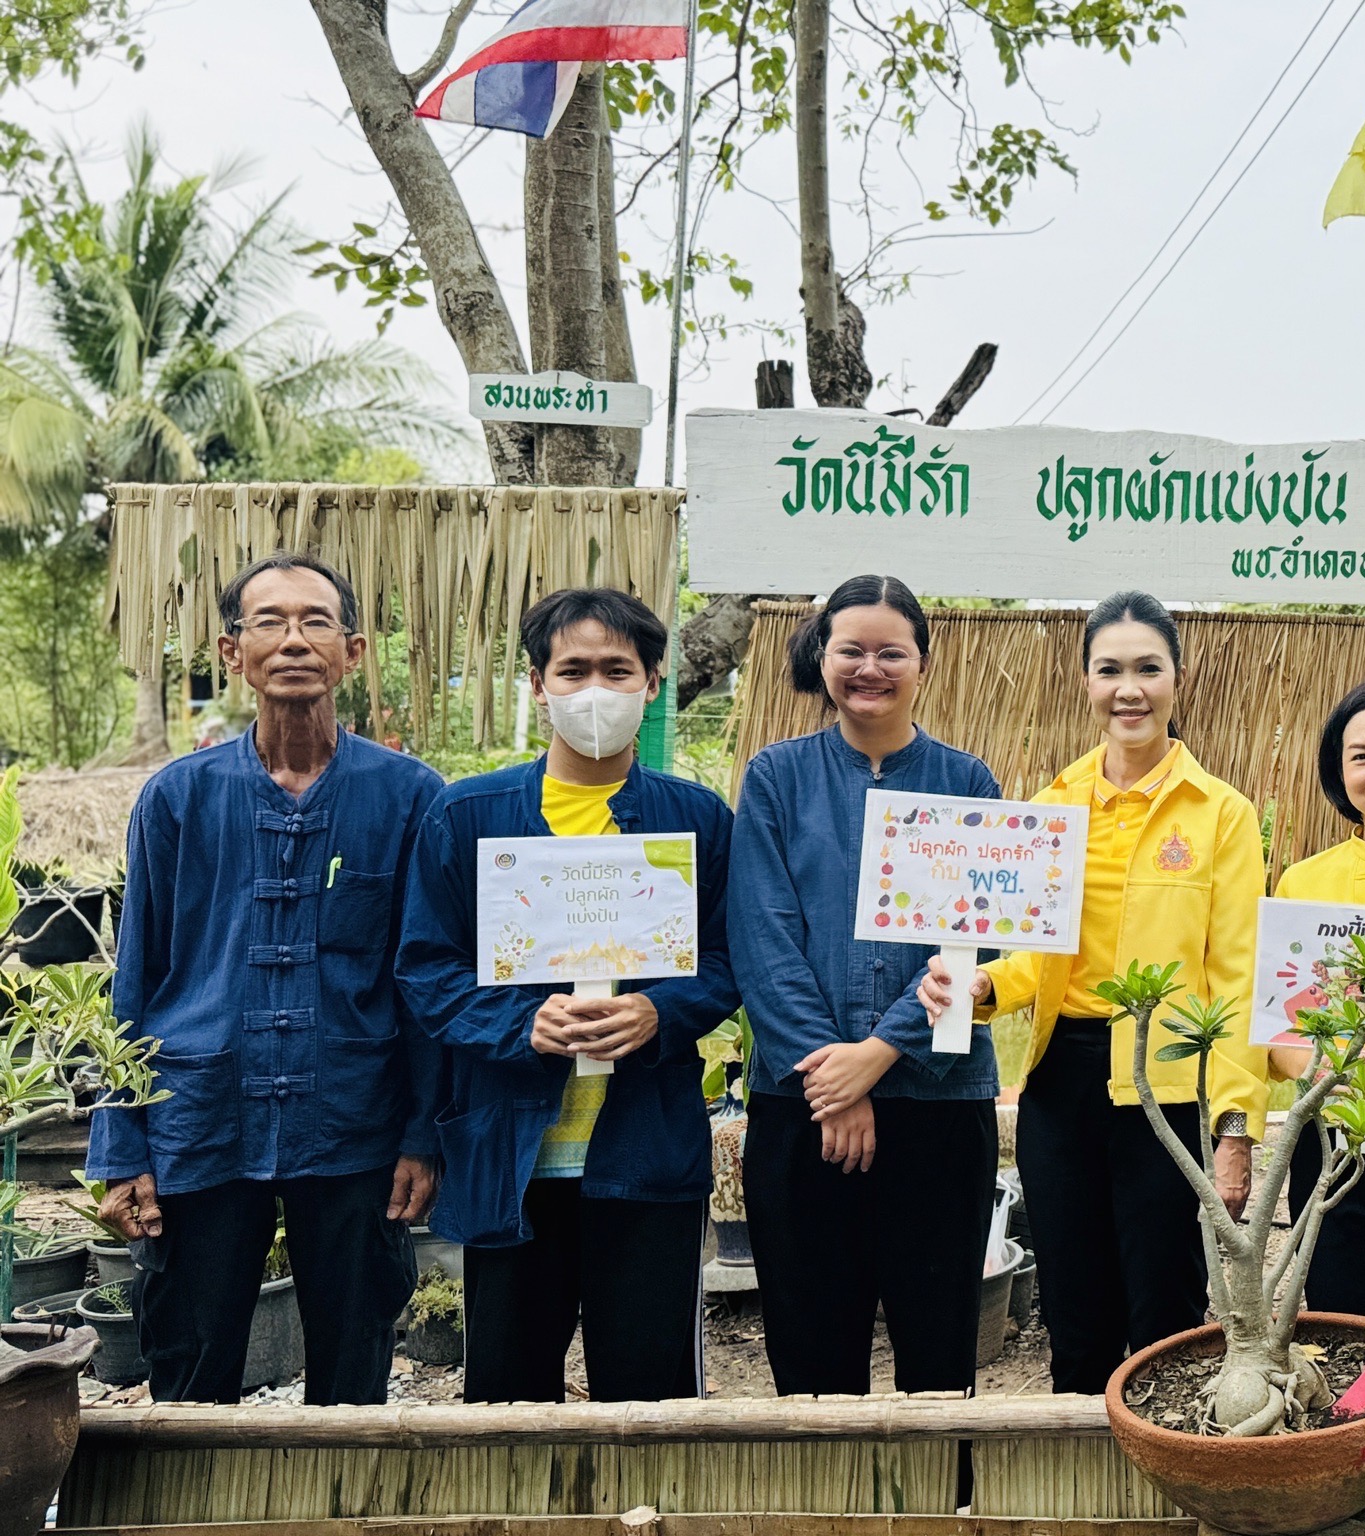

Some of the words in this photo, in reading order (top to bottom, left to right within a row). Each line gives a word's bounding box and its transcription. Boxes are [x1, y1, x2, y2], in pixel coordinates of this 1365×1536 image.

[1036, 446, 1349, 542] ปลูกผักแบ่งปัน
[908, 838, 967, 859] ปลูกผัก
[978, 843, 1034, 863] ปลูกรัก
[561, 862, 622, 881] วัดนี้มีรัก
[932, 859, 960, 880] กับ
[967, 868, 1024, 895] พช.
[566, 886, 619, 906] ปลูกผัก
[567, 908, 619, 924] แบ่งปัน
